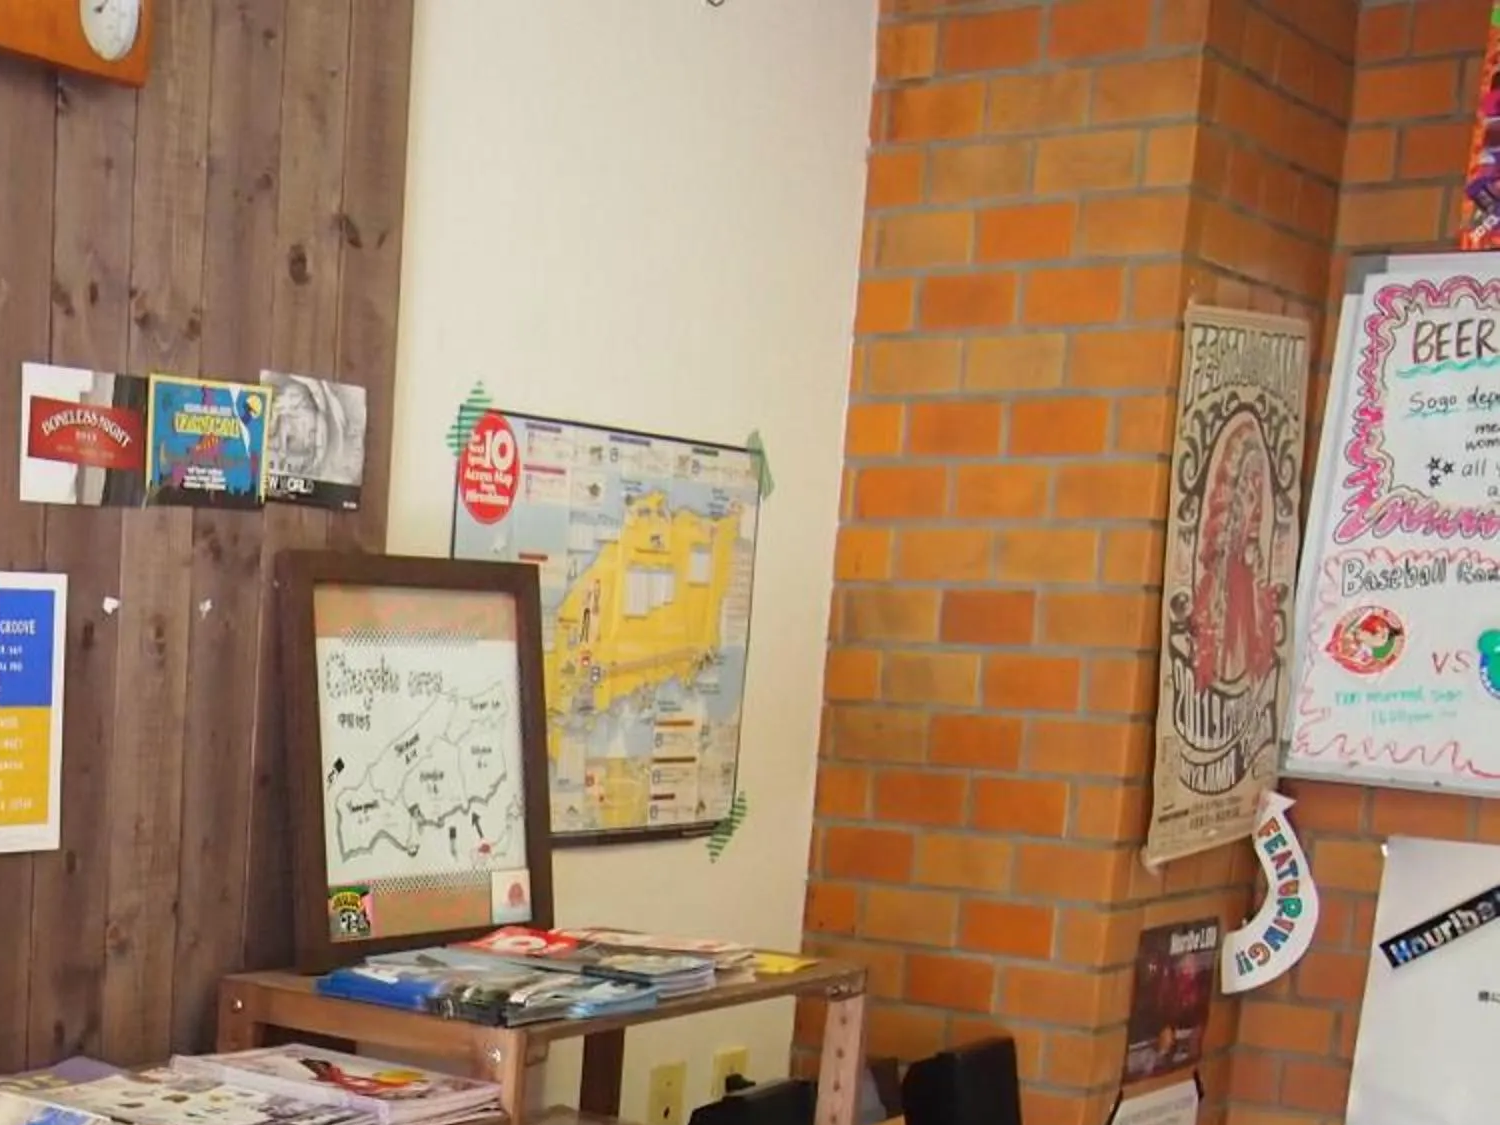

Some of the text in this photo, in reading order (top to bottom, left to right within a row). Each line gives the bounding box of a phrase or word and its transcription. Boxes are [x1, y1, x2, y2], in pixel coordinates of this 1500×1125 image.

[1412, 318, 1499, 364] BEER
[482, 428, 514, 471] 10
[1342, 558, 1447, 597] Baseball
[0, 618, 37, 636] GROOVE
